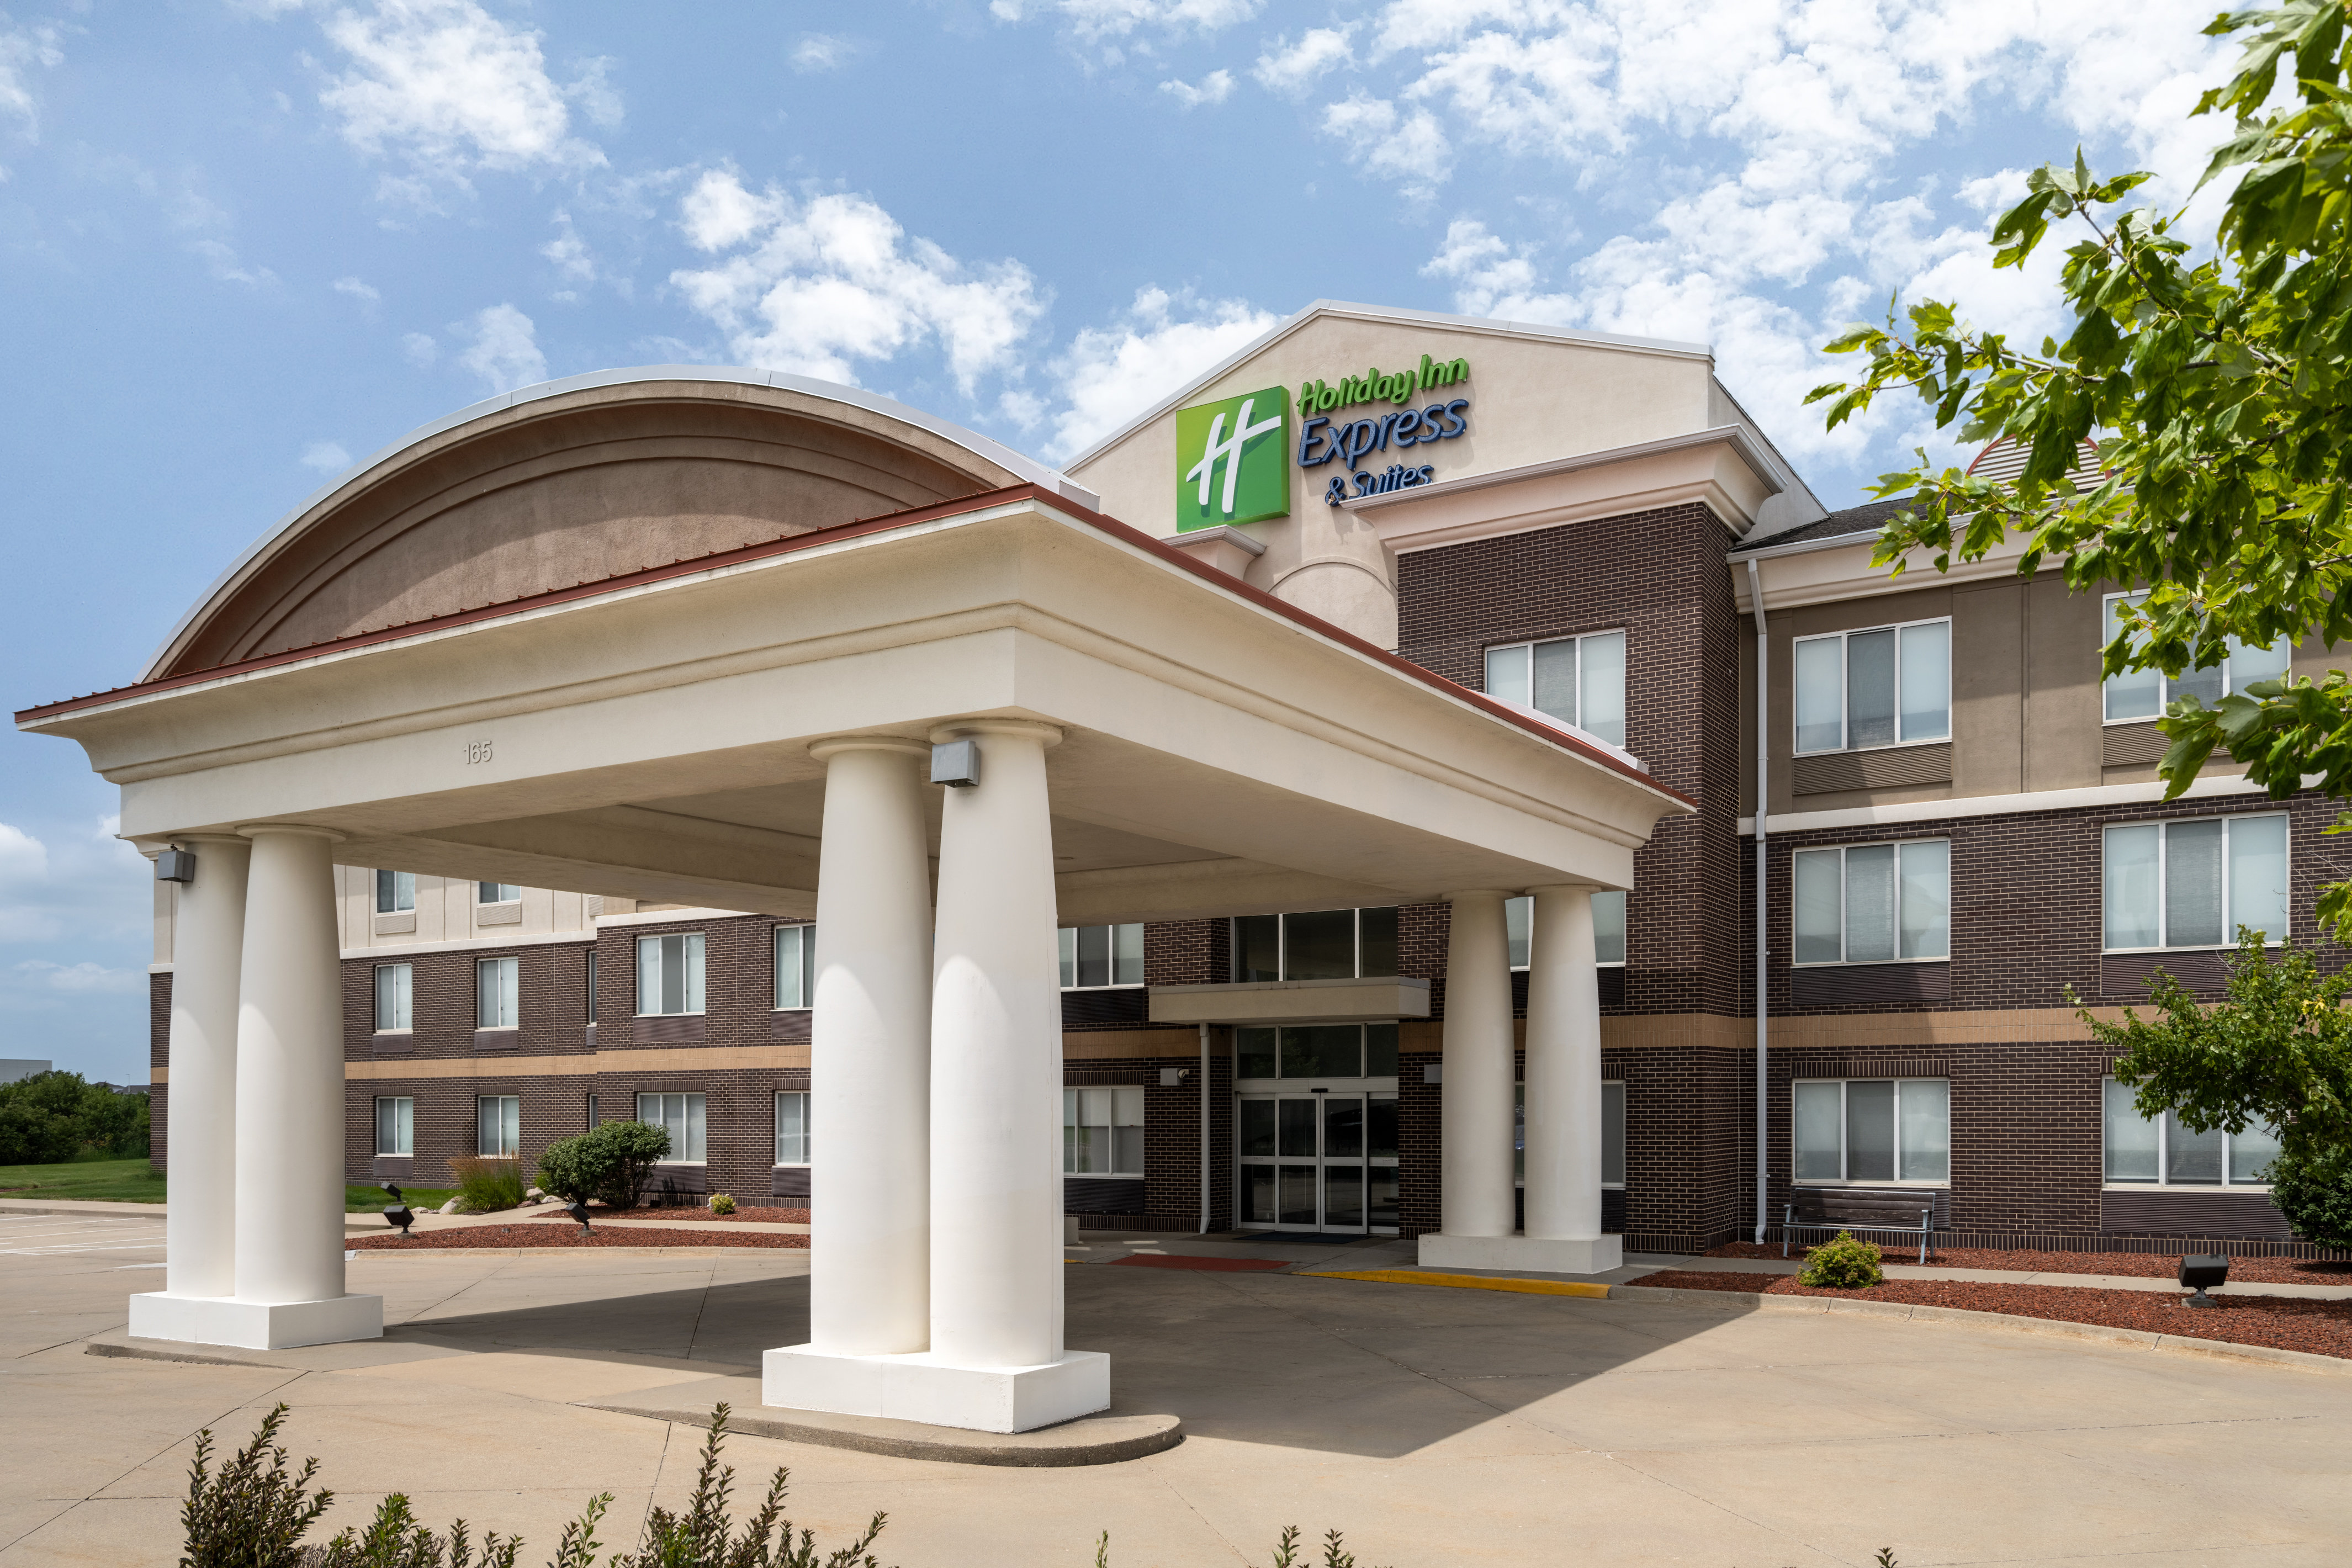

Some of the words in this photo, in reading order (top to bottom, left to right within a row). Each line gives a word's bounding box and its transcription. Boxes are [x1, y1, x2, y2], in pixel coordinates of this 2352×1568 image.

[1296, 367, 1415, 417] Holiday
[1417, 354, 1469, 391] Inn
[1297, 399, 1469, 471] Express
[1325, 476, 1347, 506] &
[1349, 464, 1434, 500] Suites
[463, 740, 492, 764] 165
